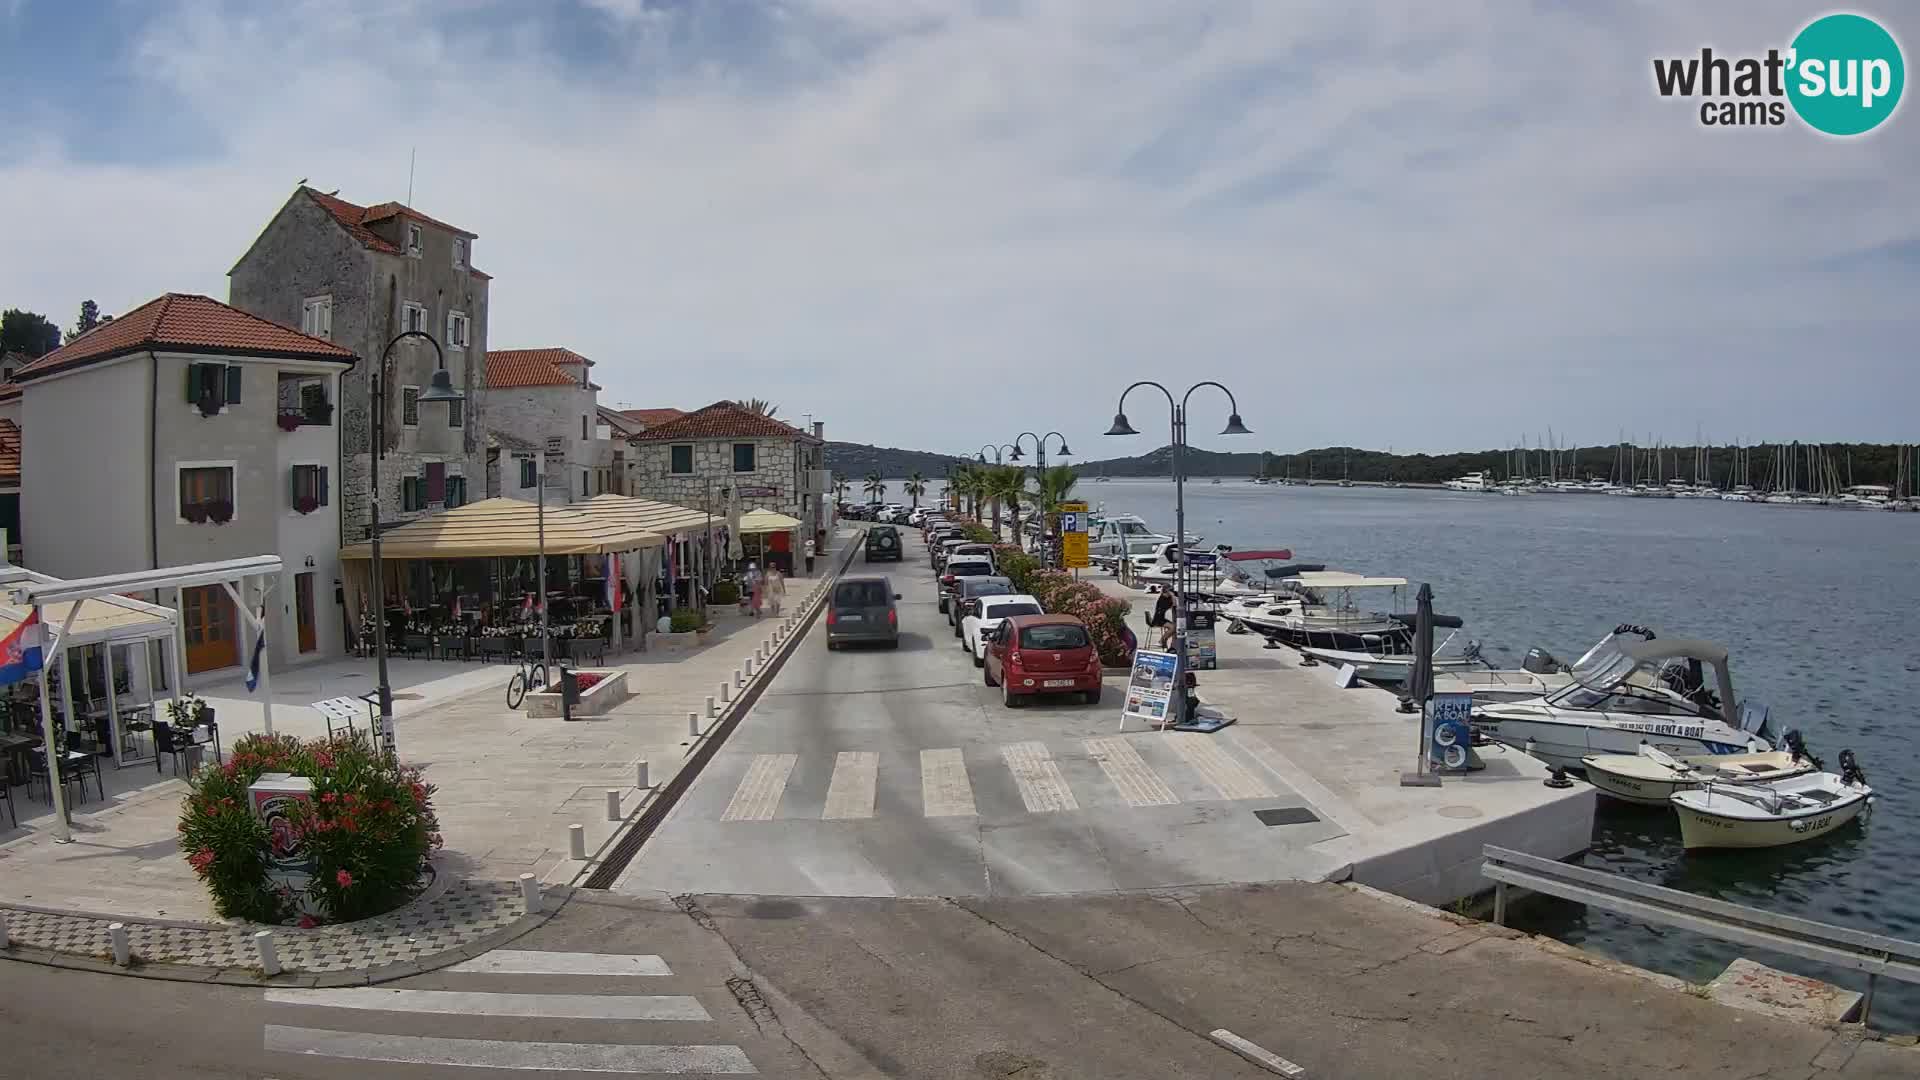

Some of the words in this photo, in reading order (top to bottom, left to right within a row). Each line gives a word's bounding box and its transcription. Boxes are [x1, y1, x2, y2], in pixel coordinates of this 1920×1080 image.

[1064, 514, 1076, 531] P
[1435, 699, 1470, 711] RENT
[1444, 711, 1470, 720] BOAT
[1655, 724, 1676, 735] RENT
[1677, 726, 1683, 736] A
[1684, 726, 1704, 738] BOAT
